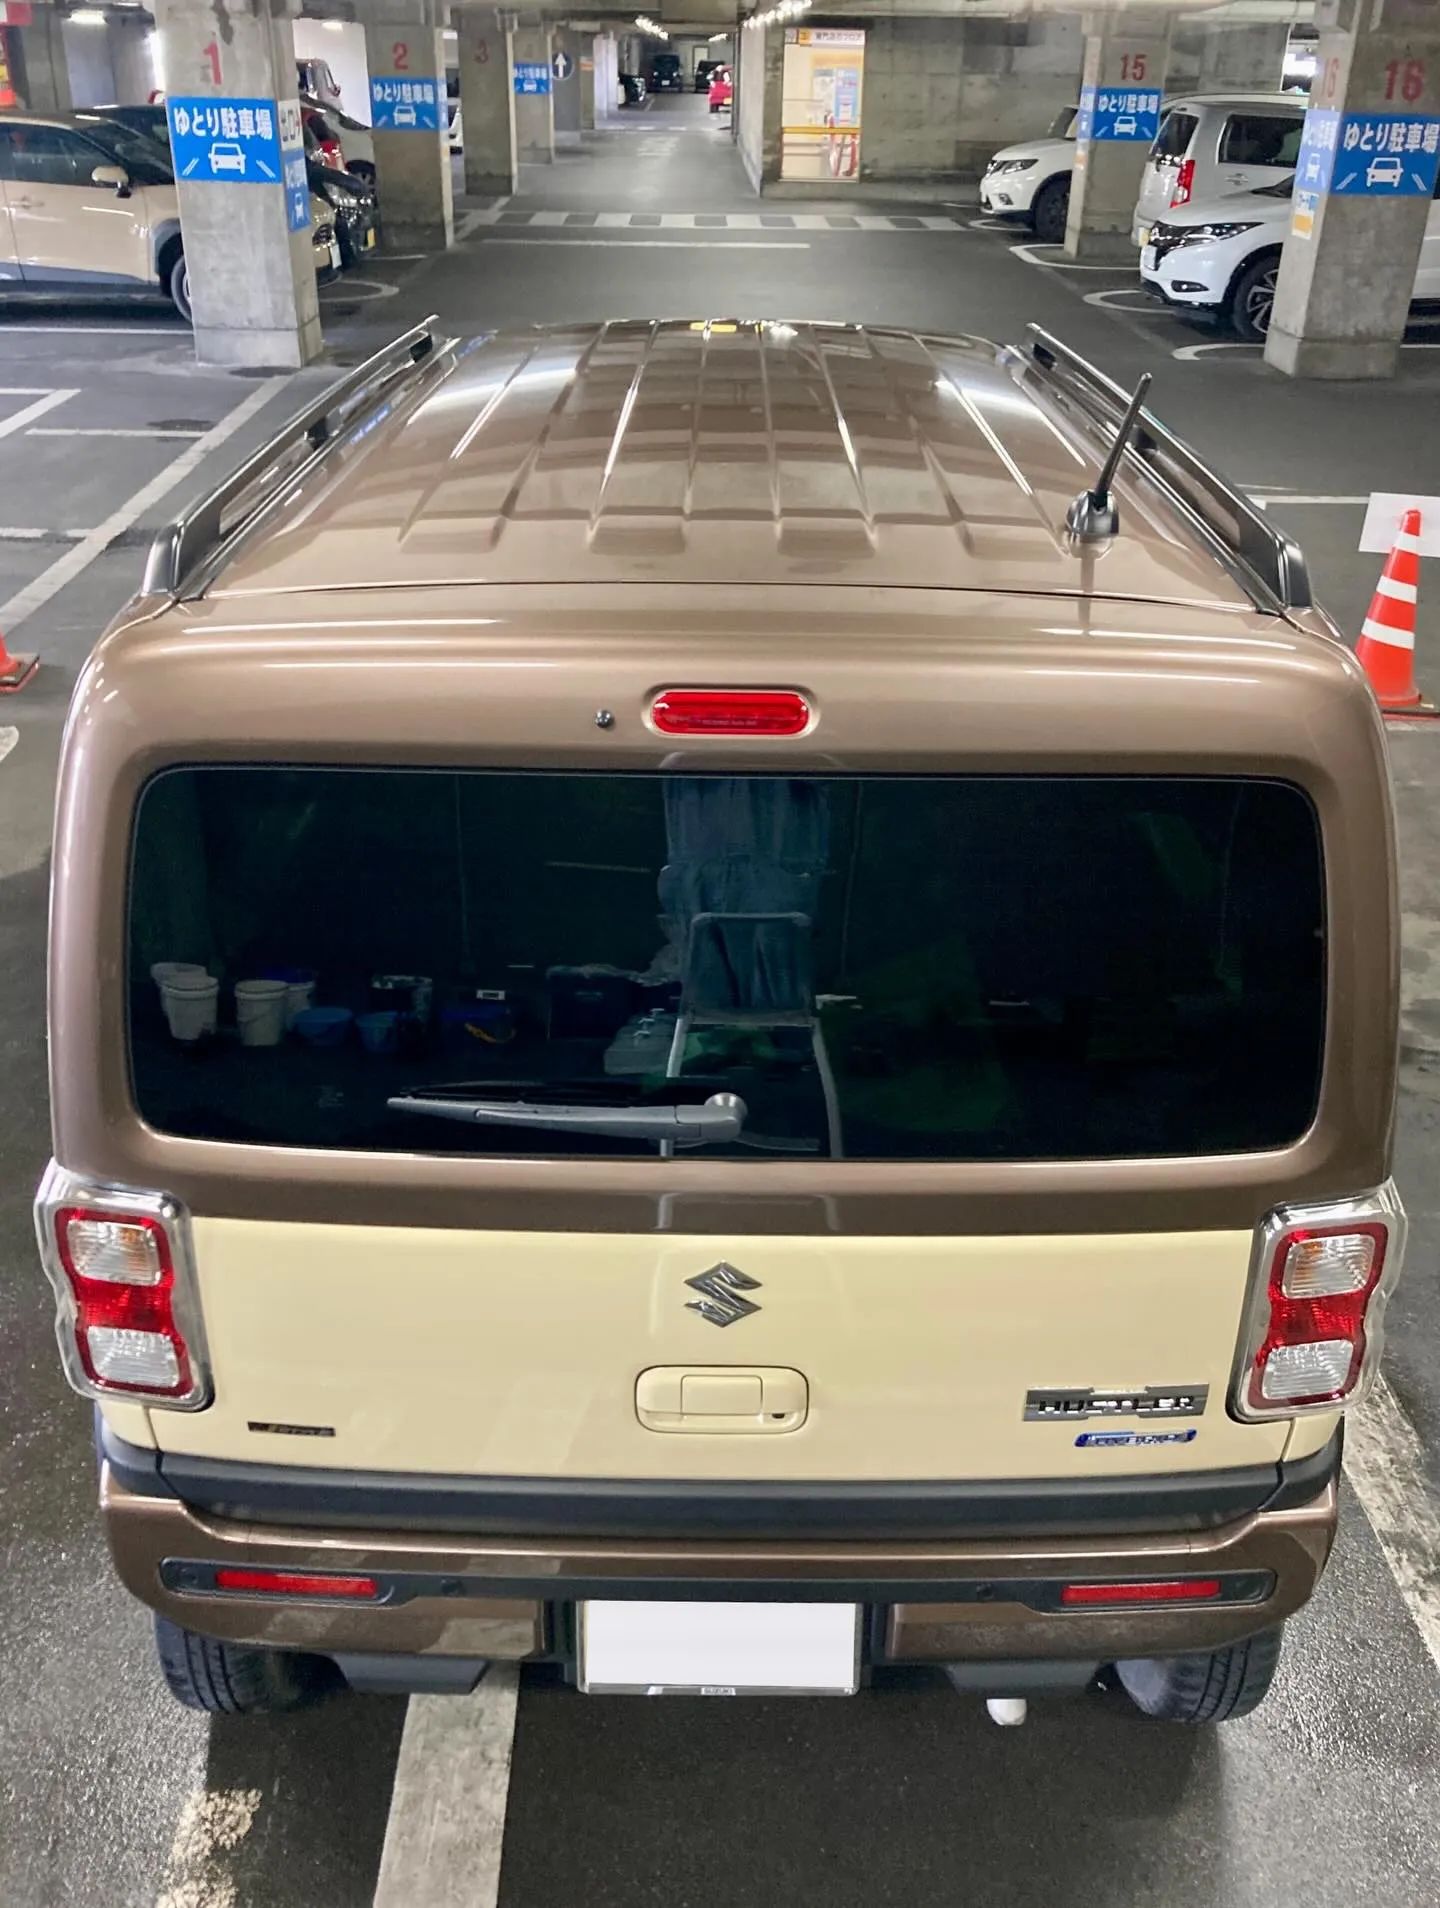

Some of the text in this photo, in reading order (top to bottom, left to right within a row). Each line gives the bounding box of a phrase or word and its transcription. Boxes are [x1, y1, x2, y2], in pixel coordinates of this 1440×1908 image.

[203, 40, 222, 85] 1
[393, 42, 409, 70] 2
[474, 40, 489, 64] 3
[1121, 53, 1147, 81] 15
[1384, 58, 1426, 103] 16
[173, 106, 273, 140] ゆとり駐車場
[1342, 122, 1440, 154] ゆとり駐車場
